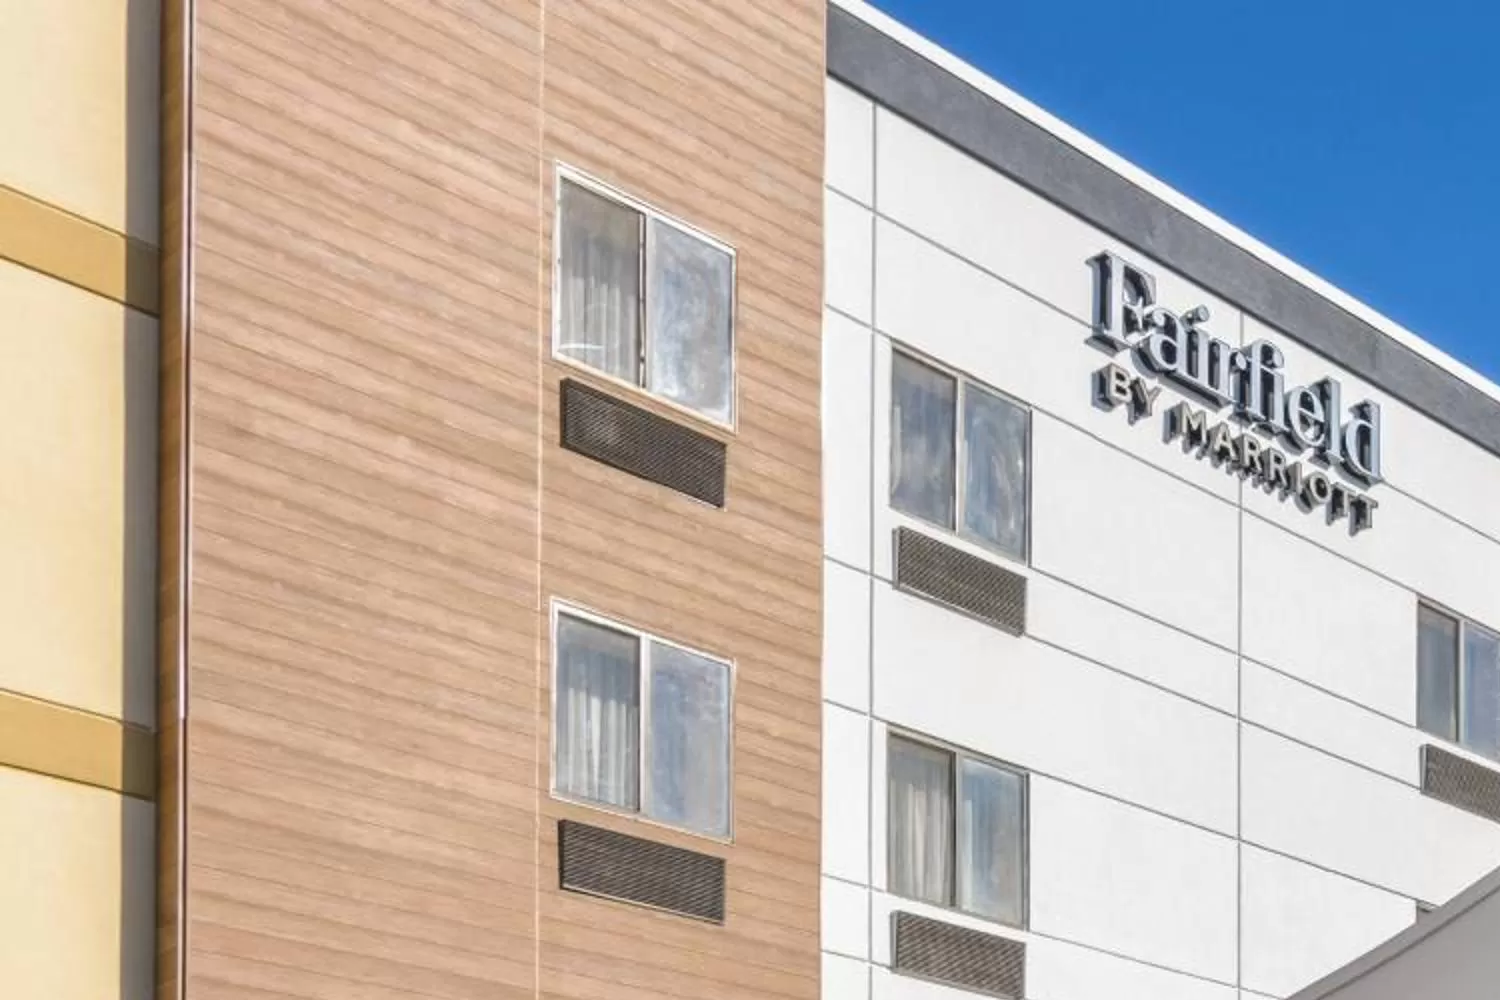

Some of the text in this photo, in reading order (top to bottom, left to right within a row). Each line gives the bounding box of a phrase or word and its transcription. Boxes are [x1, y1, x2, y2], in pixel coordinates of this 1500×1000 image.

[1085, 249, 1383, 490] Fairfield
[1091, 362, 1378, 536] BY MARRIOTT
